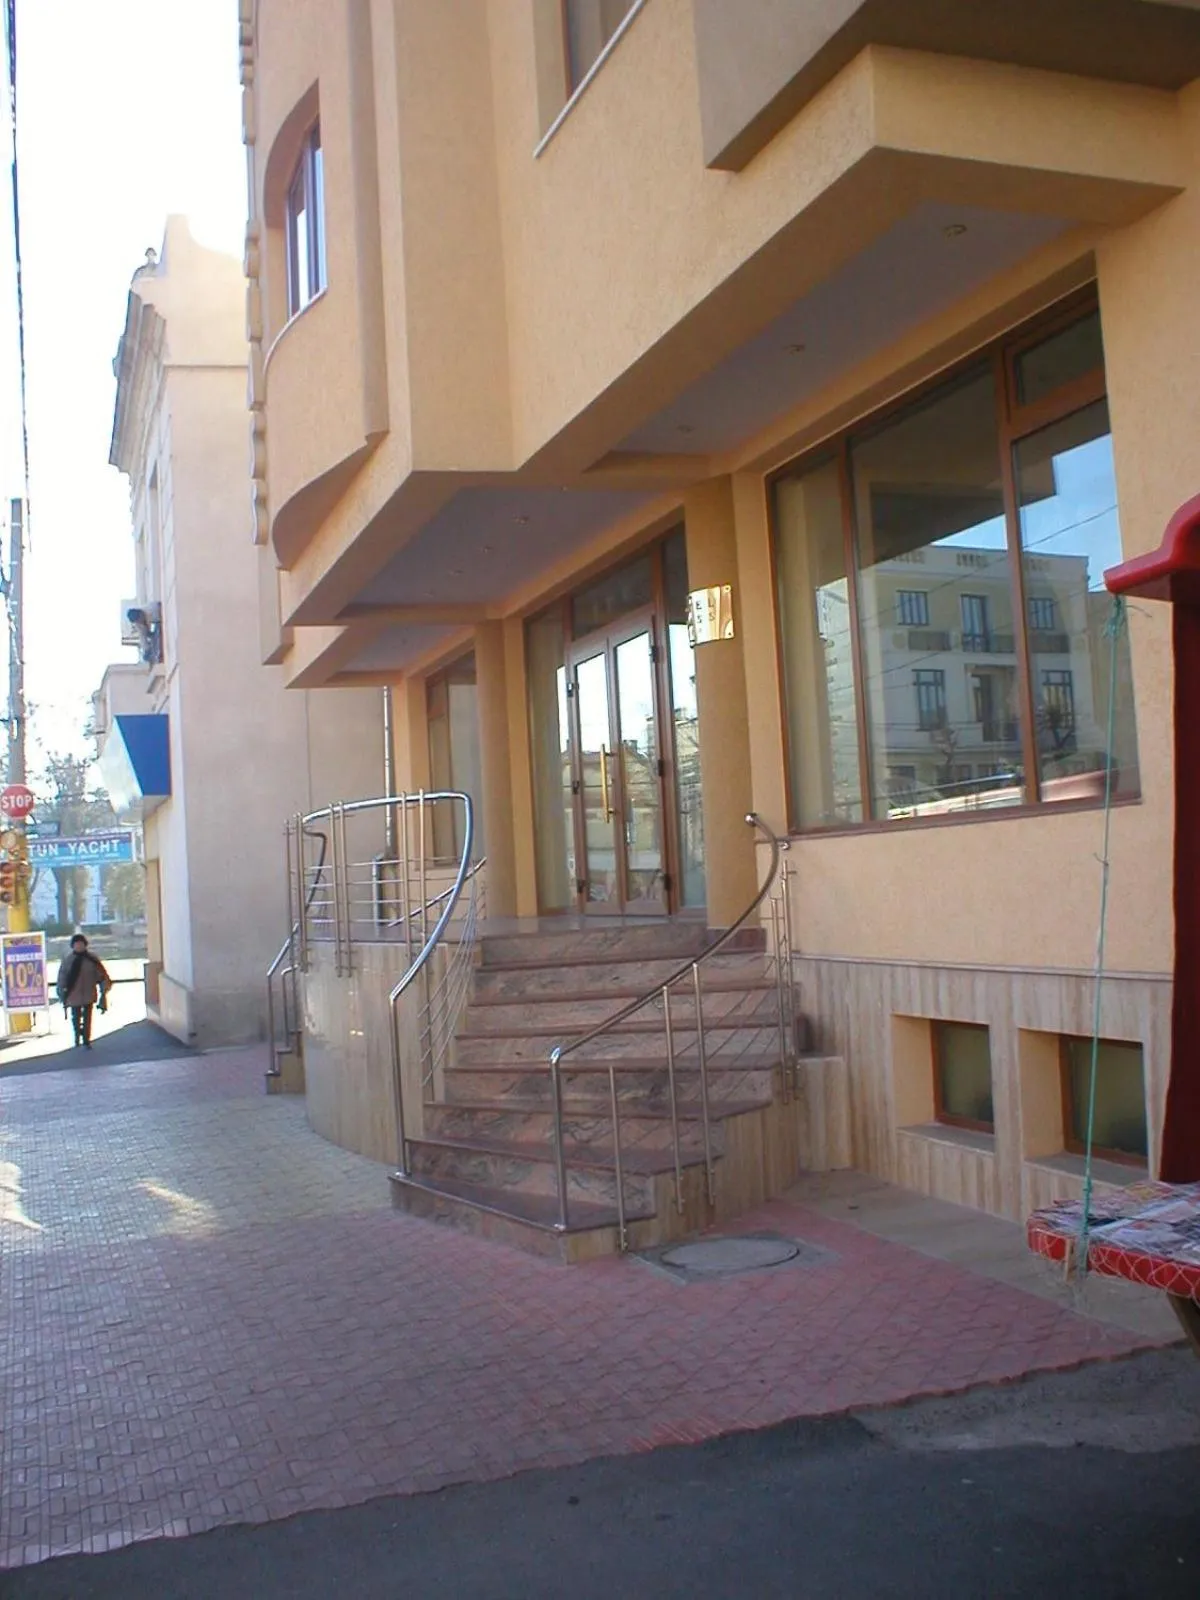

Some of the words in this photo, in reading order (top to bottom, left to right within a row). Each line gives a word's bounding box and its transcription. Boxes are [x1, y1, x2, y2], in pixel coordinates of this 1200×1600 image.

[2, 795, 32, 809] STOP
[68, 840, 120, 855] YACHT
[6, 962, 43, 990] 10%
